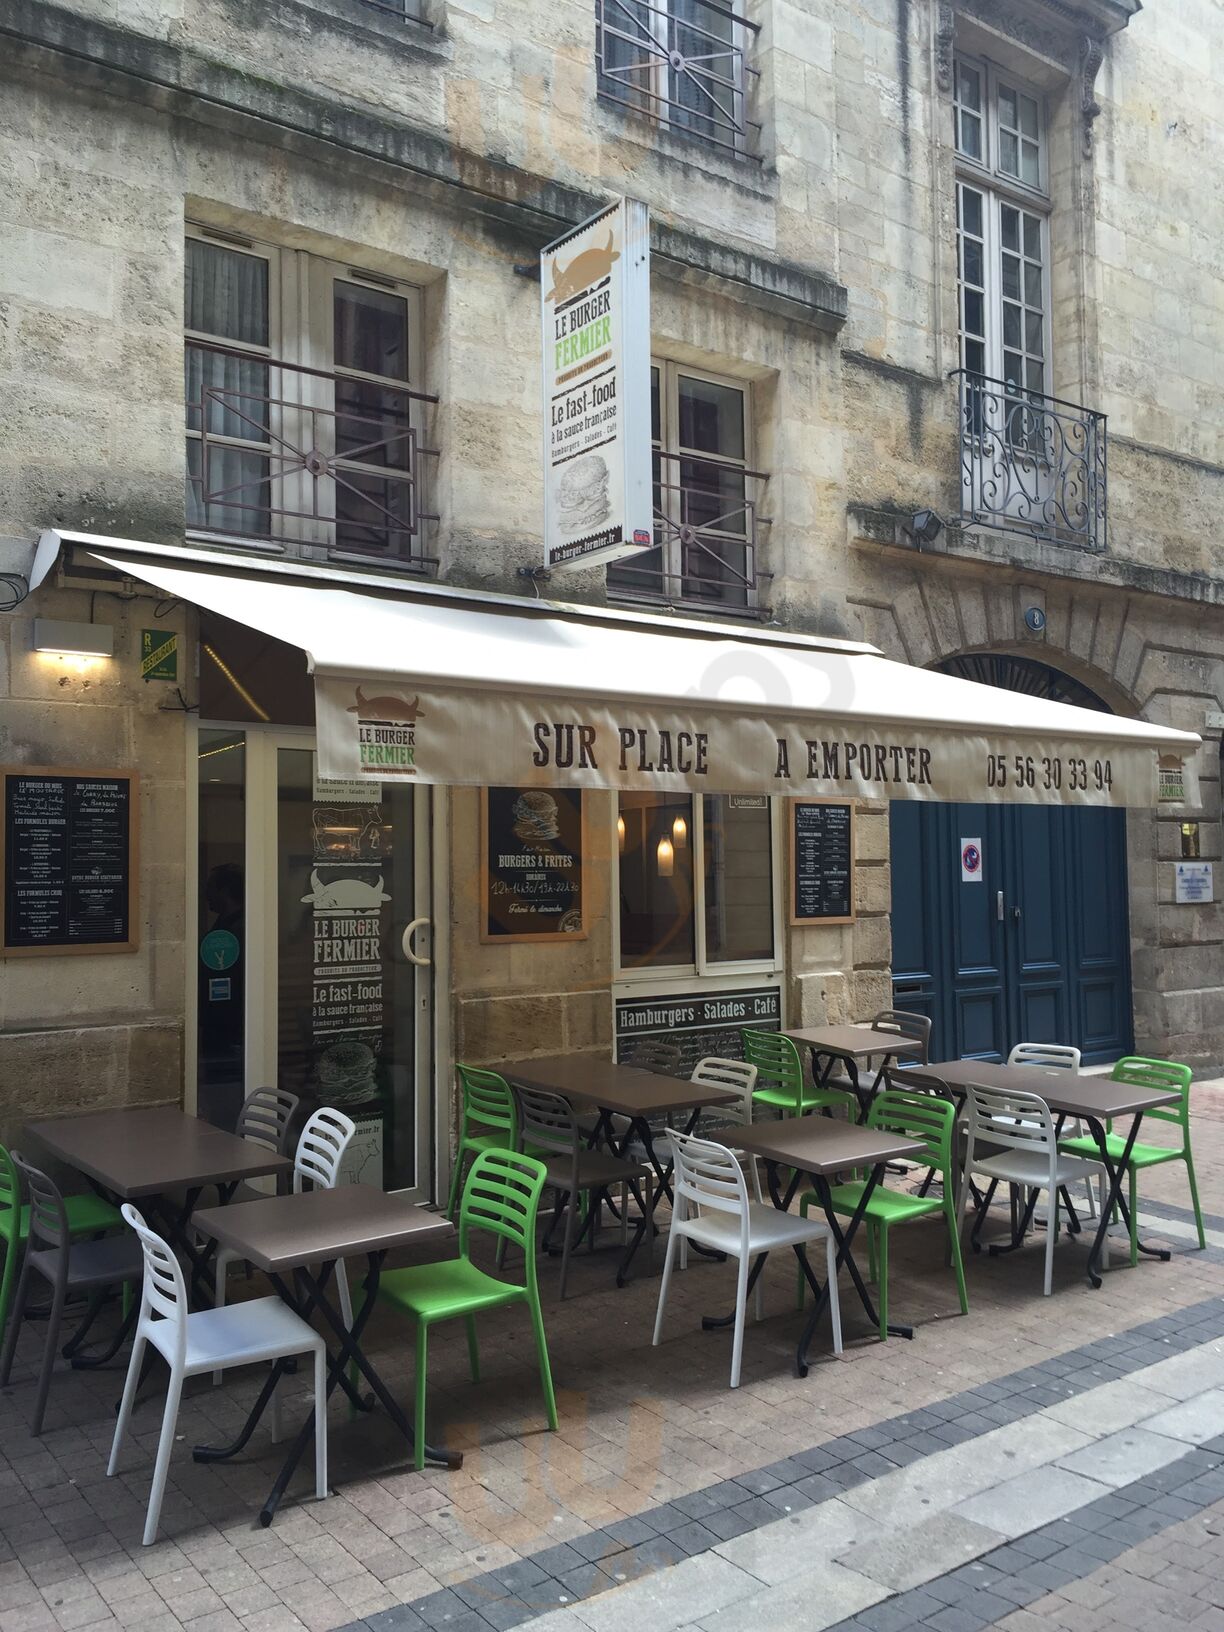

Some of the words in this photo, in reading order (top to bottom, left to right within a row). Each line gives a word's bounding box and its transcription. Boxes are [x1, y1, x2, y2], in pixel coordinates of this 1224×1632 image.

[555, 315, 567, 340] LE
[570, 290, 611, 333] BURGER
[555, 316, 611, 371] FERMIER
[551, 405, 564, 427] Le
[566, 376, 616, 420] fast-food
[557, 429, 563, 442] la
[564, 421, 583, 439] sauce
[585, 405, 617, 430] française
[554, 533, 615, 562] le-burger-fermier.fr
[359, 728, 371, 743] LE
[374, 729, 415, 745] BURGER
[533, 722, 598, 769] SUR
[618, 727, 709, 775] PLACE
[359, 745, 415, 765] FERMIER
[774, 739, 790, 778] A
[807, 740, 932, 785] EMPORTER
[987, 754, 1006, 788] 05
[1015, 756, 1035, 789] 56
[1042, 757, 1061, 790] 30
[1068, 759, 1087, 791] 33
[1094, 760, 1113, 791] 94
[498, 854, 536, 868] BURGERS
[537, 855, 543, 867] &
[545, 854, 573, 868] FRITES
[530, 905, 536, 913] le
[538, 904, 563, 913] dimanche
[313, 920, 328, 938] LE
[332, 919, 380, 938] BURGER
[313, 938, 381, 963] FERMIER
[313, 987, 327, 1003] Le
[329, 983, 383, 1002] fast-food
[312, 1019, 344, 1028] Hamburgers
[349, 1017, 367, 1025] Salades
[318, 1005, 326, 1016] la
[327, 1006, 348, 1016] sauce
[349, 1002, 384, 1014] française
[620, 1007, 694, 1027] Hamburgers
[704, 1001, 746, 1020] Salades
[754, 997, 777, 1015] Café
